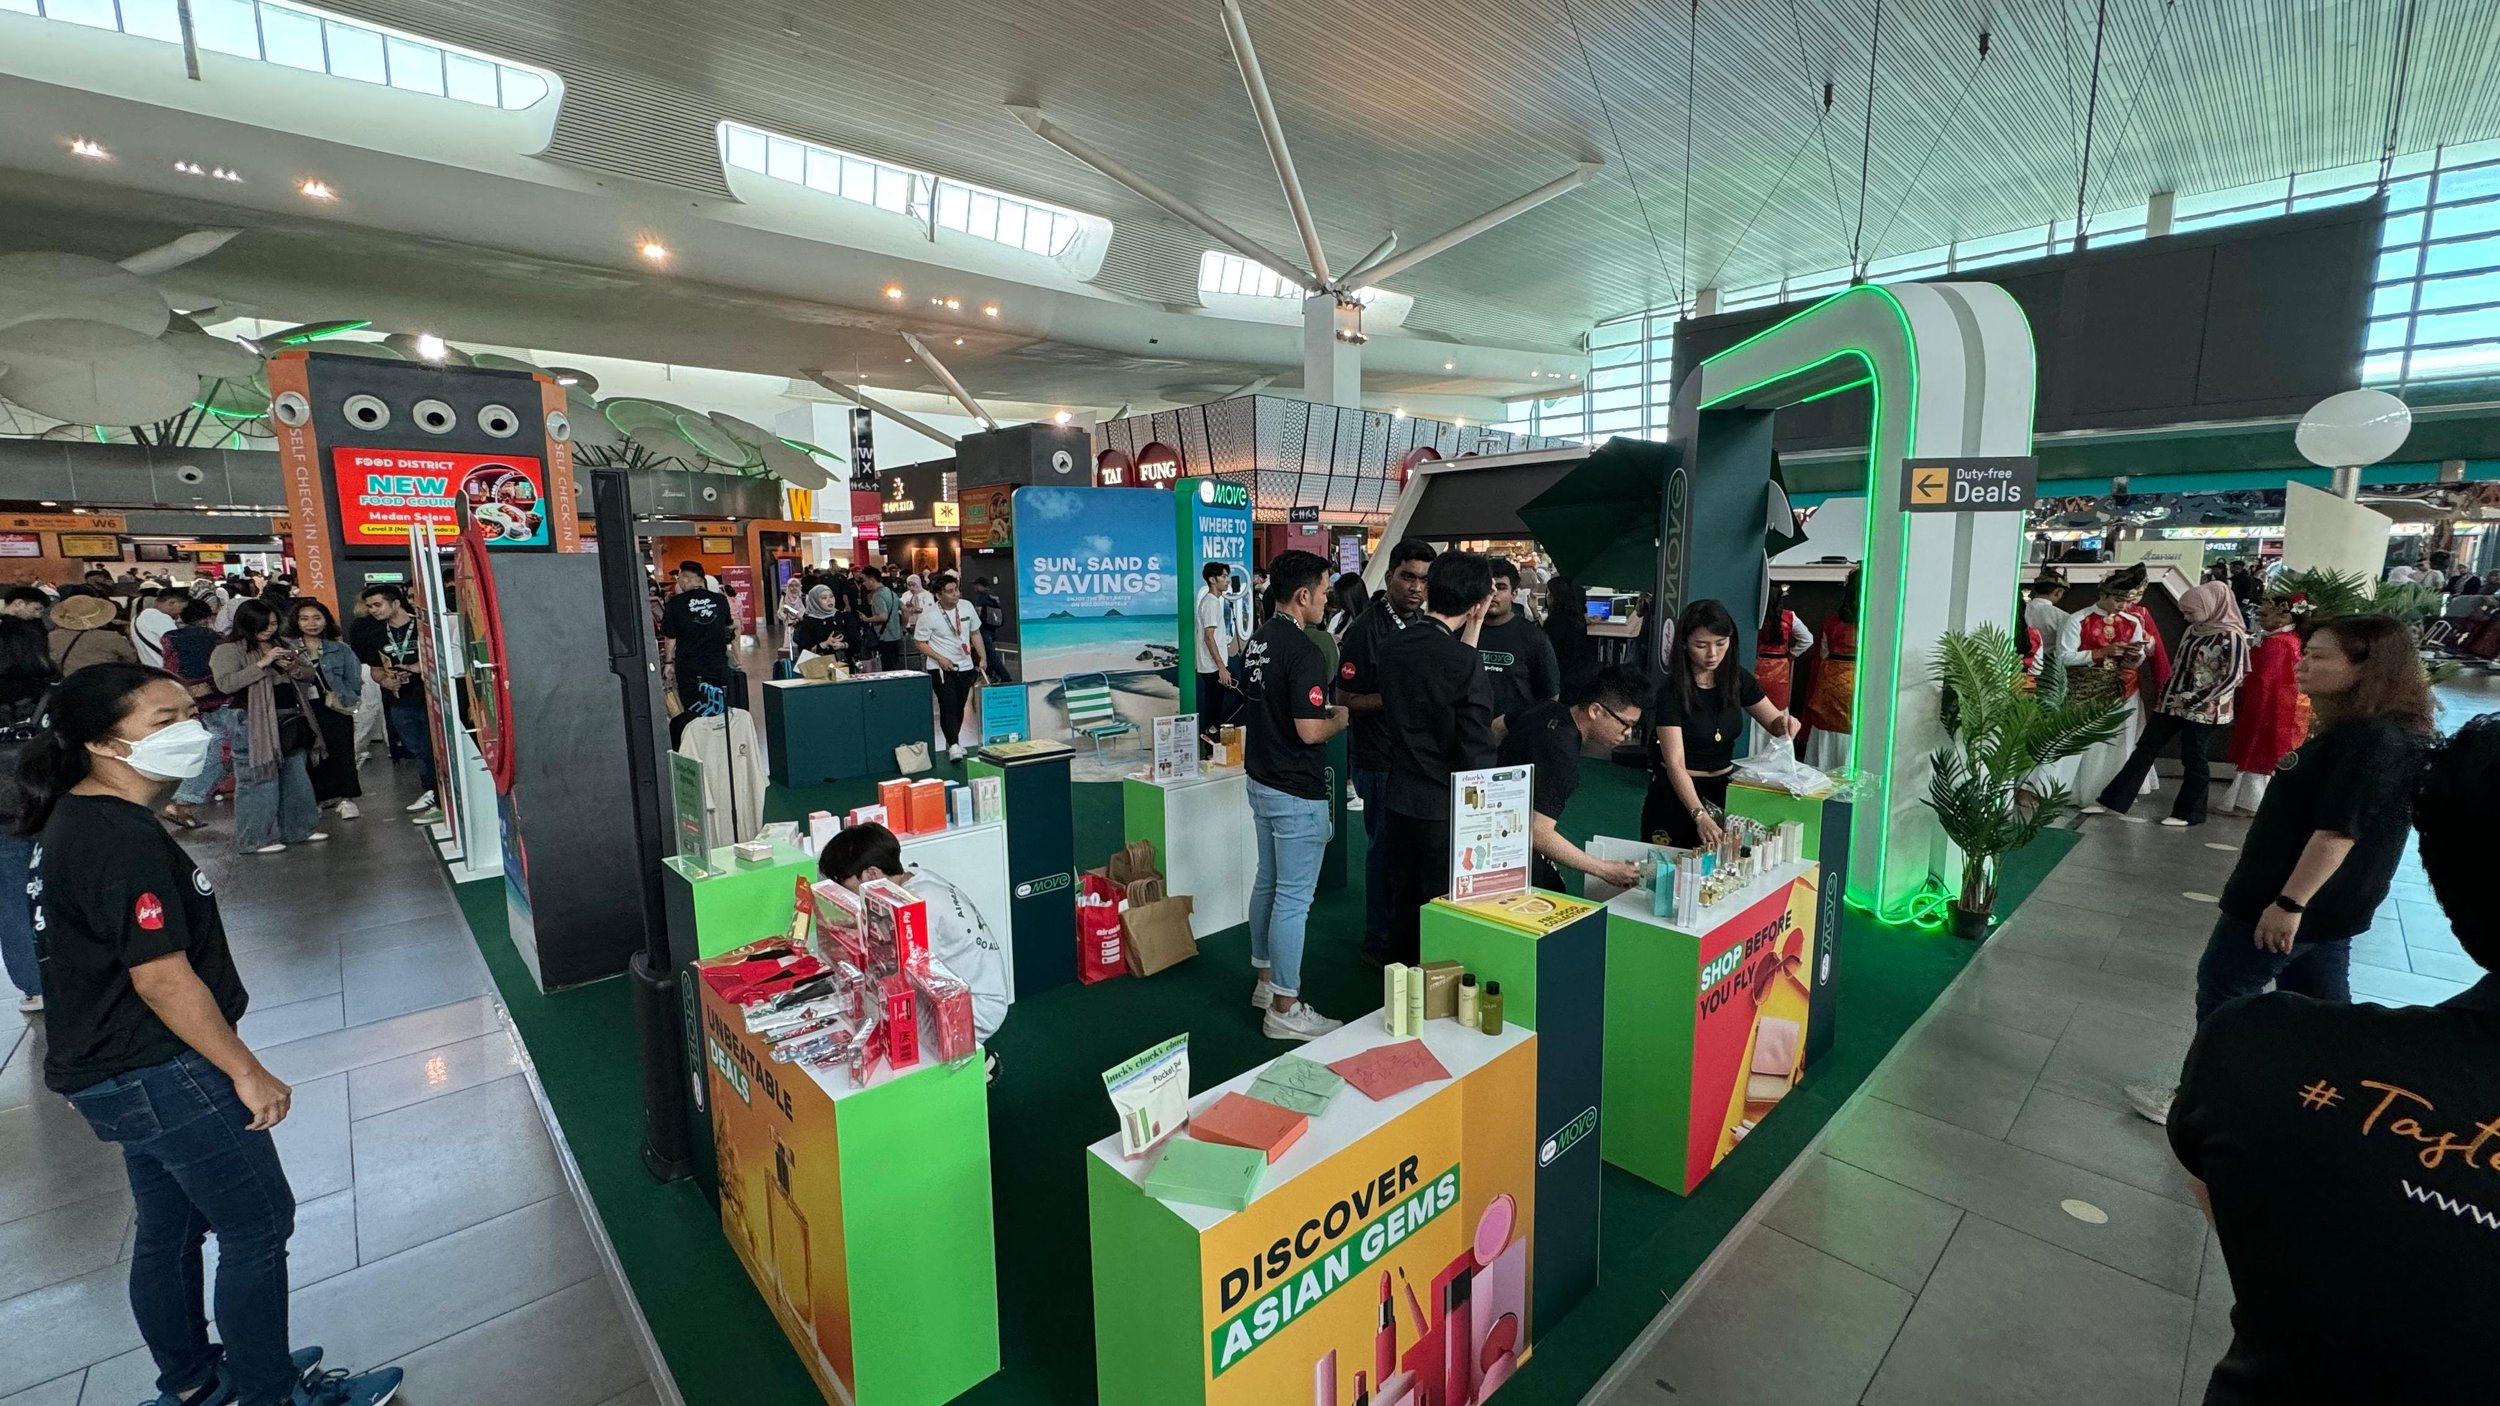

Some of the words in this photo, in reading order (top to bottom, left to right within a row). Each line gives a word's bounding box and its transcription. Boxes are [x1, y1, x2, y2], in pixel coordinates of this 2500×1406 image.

[289, 428, 305, 462] SELF
[858, 448, 873, 459] W
[355, 457, 393, 468] FOOD
[398, 459, 455, 470] DISTRICT
[555, 442, 565, 473] SELF
[862, 462, 872, 474] X
[1102, 467, 1122, 485] TAI
[1139, 461, 1177, 481] FUNG
[1956, 468, 2012, 481] Duty-free
[367, 475, 448, 496] NEW
[1954, 480, 2021, 502] Deals
[296, 467, 318, 540] CHECK-IN
[359, 496, 405, 507] FOOD
[407, 497, 456, 507] COURT
[557, 476, 573, 540] CHECK-IN
[787, 488, 813, 521] W
[93, 519, 116, 528] W6
[369, 512, 411, 521] Medan
[1199, 516, 1234, 533] WHERE
[1234, 518, 1247, 533] TO
[1202, 535, 1245, 558] NEXT?
[307, 545, 324, 589] KIOSK
[1033, 556, 1082, 574] SUN,
[1087, 556, 1143, 571] SAND
[1147, 556, 1161, 571] &
[1033, 573, 1161, 595] SAVINGS
[903, 911, 912, 923] Fly
[905, 925, 914, 939] Can
[975, 937, 988, 949] GO
[1700, 944, 1742, 991] SHOP
[1744, 909, 1792, 960] BEFORE
[1700, 981, 1730, 1021] YOU
[1734, 961, 1756, 996] FLY
[707, 1005, 793, 1123] UNBEATABLE
[709, 1037, 749, 1104] DEALS
[1106, 1063, 1133, 1084] huck's
[1135, 1048, 1164, 1068] chuck's
[1152, 1065, 1175, 1084] Pocket
[1220, 1154, 1419, 1314] DISCOVER
[1220, 1245, 1349, 1369] ASIAN
[1360, 1173, 1455, 1263] GEMS
